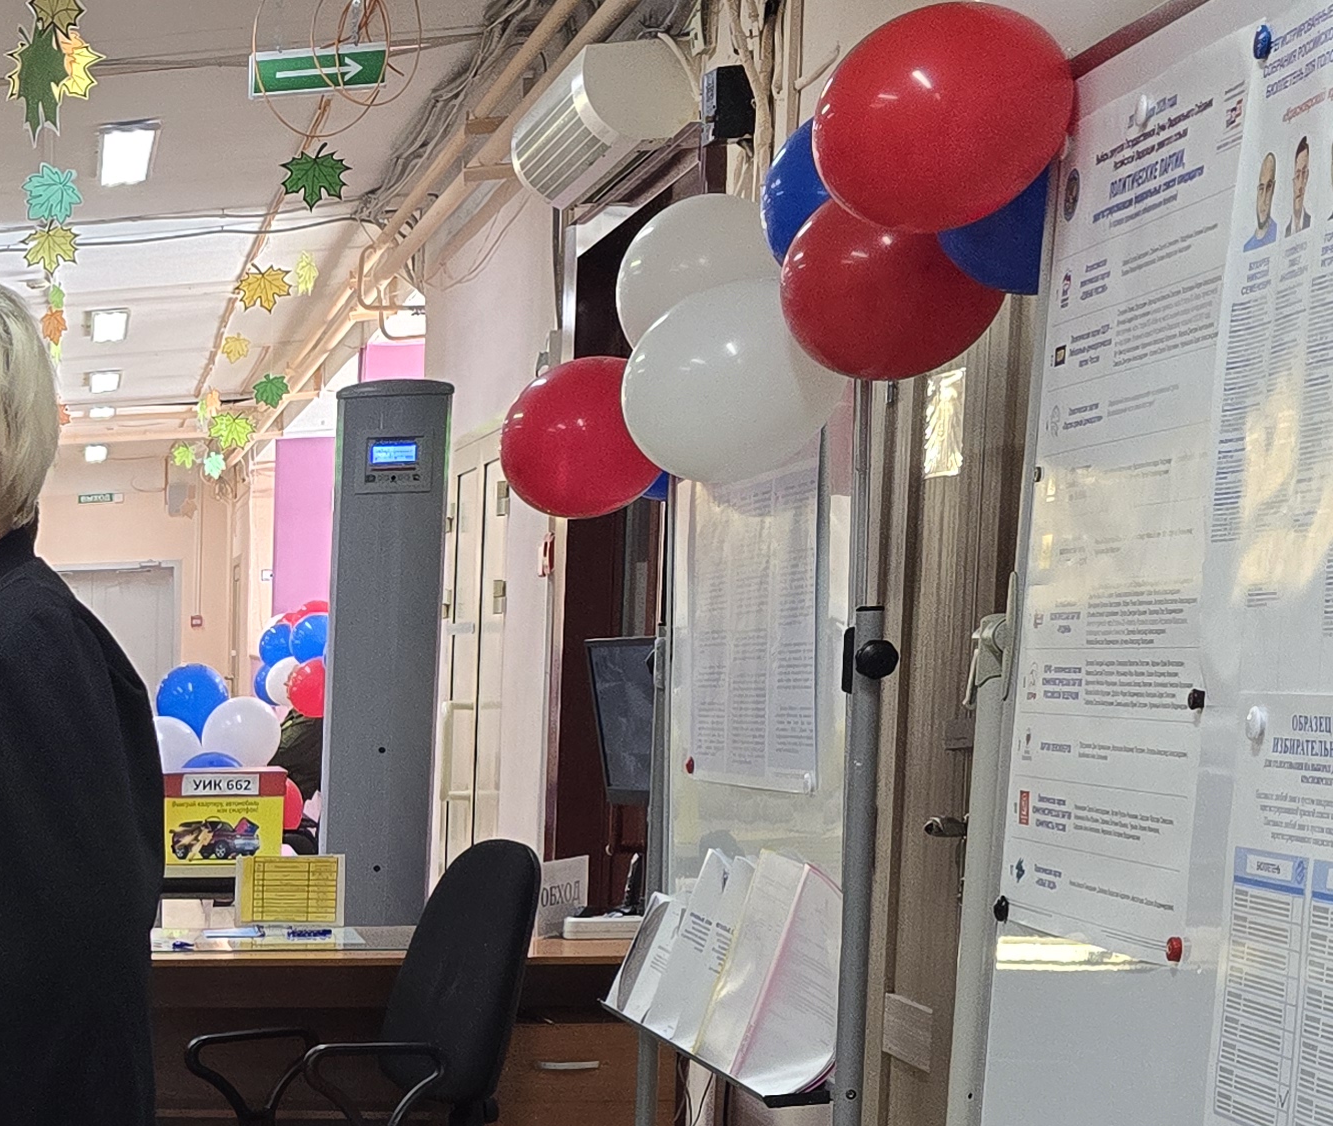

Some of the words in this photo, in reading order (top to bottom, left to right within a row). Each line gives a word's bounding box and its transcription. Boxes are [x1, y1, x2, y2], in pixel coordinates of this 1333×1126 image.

[1292, 714, 1332, 734] ОБРАЗЕЦ
[193, 779, 222, 790] УИК
[226, 780, 251, 790] 662
[541, 880, 581, 907] ОБХОД
